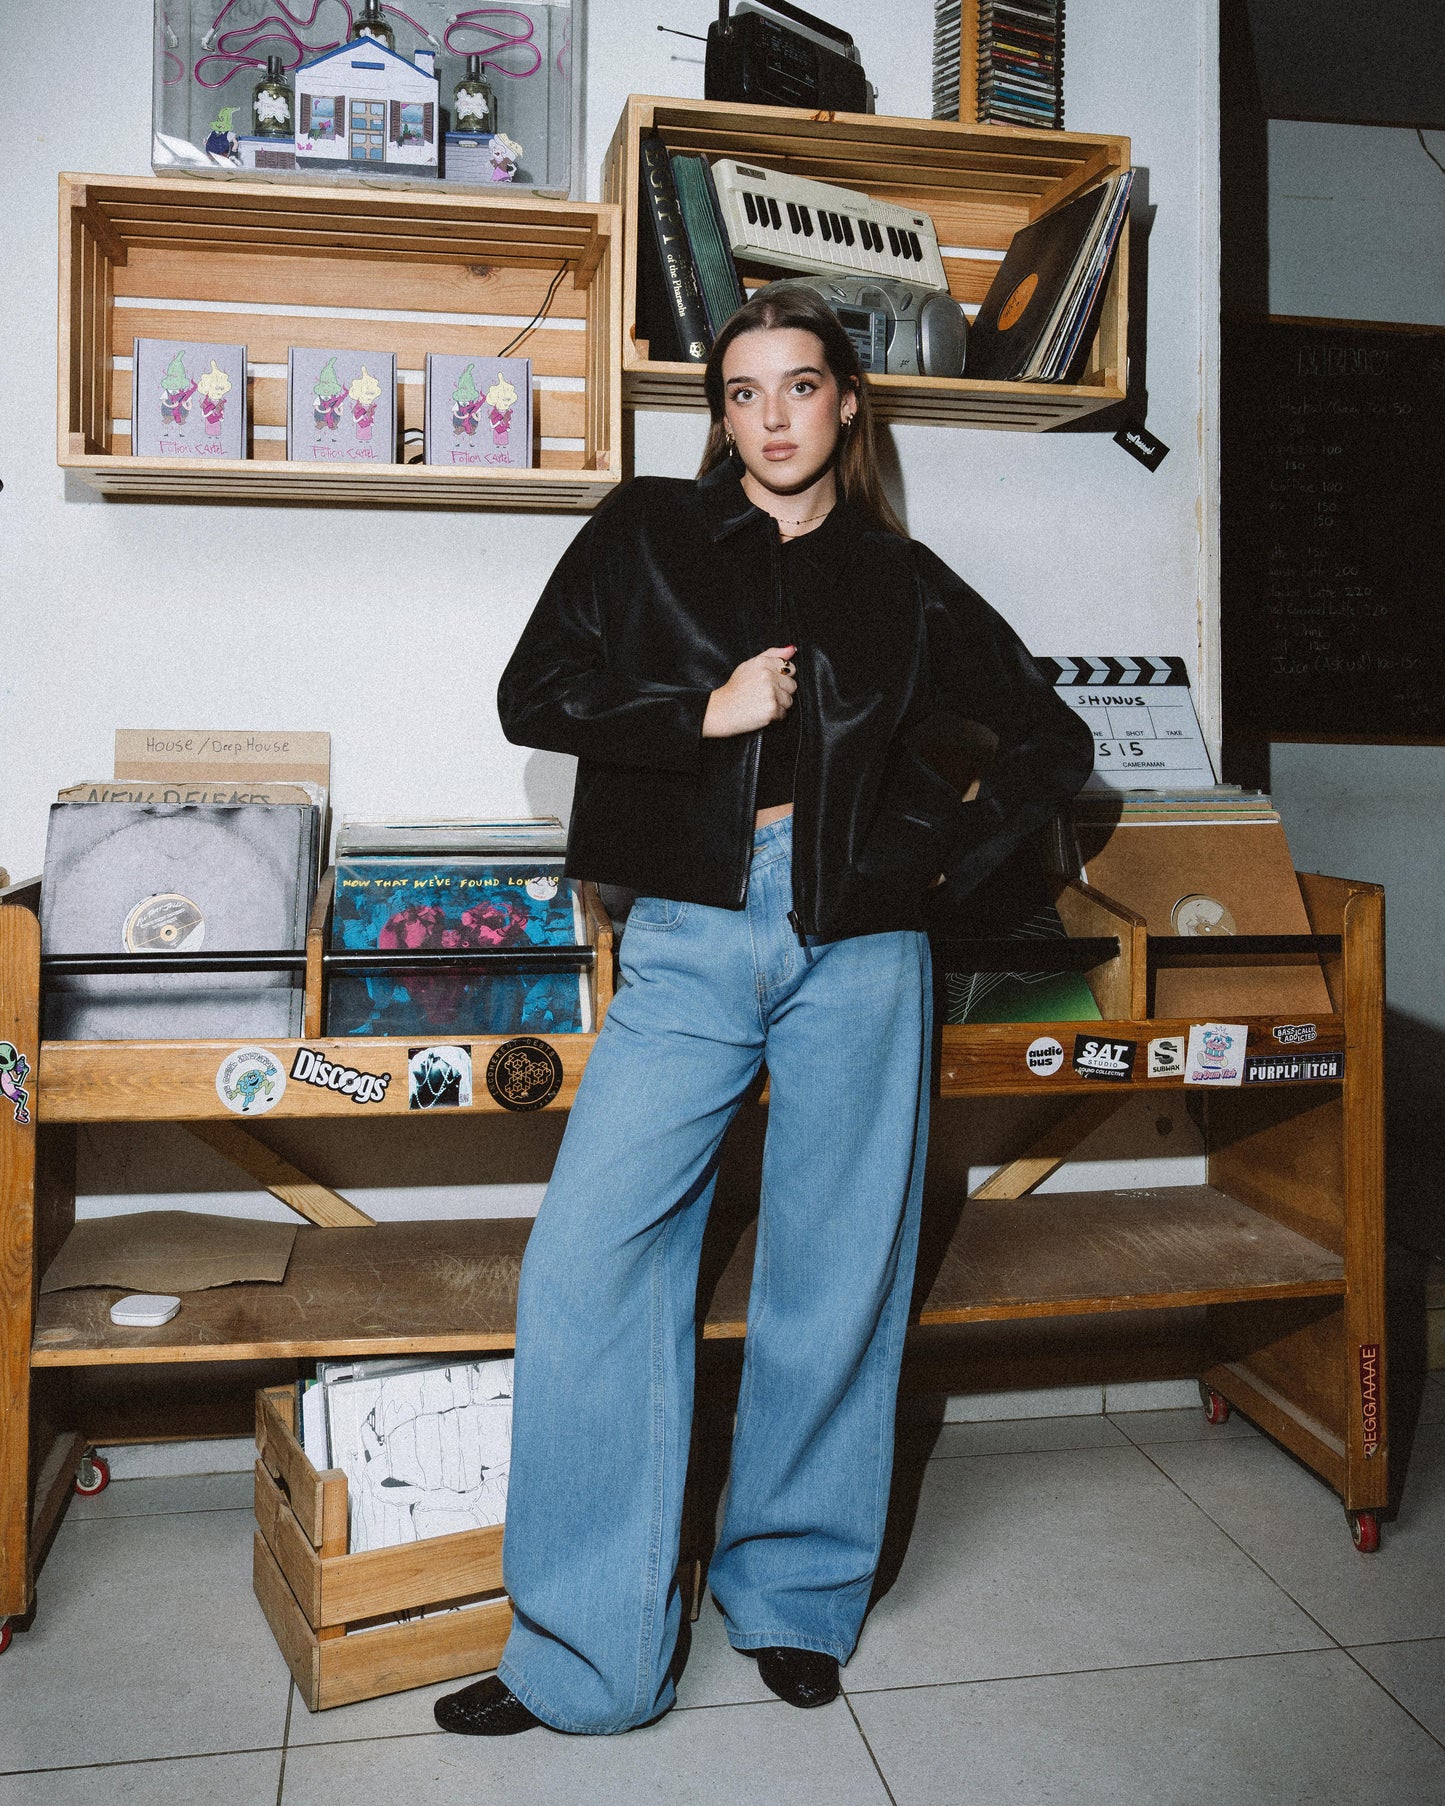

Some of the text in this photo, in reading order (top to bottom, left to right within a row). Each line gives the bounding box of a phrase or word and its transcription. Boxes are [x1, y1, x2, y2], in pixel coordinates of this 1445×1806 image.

[644, 148, 680, 245] EGYPT
[667, 254, 675, 264] of
[669, 264, 678, 278] the
[672, 279, 686, 318] Pharaohs
[1078, 695, 1146, 706] SHUNUS
[342, 879, 371, 888] NOW
[375, 879, 409, 888] THAT
[414, 875, 451, 888] WE'VE
[460, 878, 500, 888] FOUND
[1028, 1046, 1062, 1058] audio
[1082, 1041, 1128, 1061] SAT
[1029, 1058, 1053, 1067] bus
[1087, 1059, 1119, 1068] STUDIO
[1152, 1064, 1180, 1073] SUBWAX
[292, 1049, 388, 1103] Discogs
[1095, 1068, 1125, 1077] COLLECTIVE
